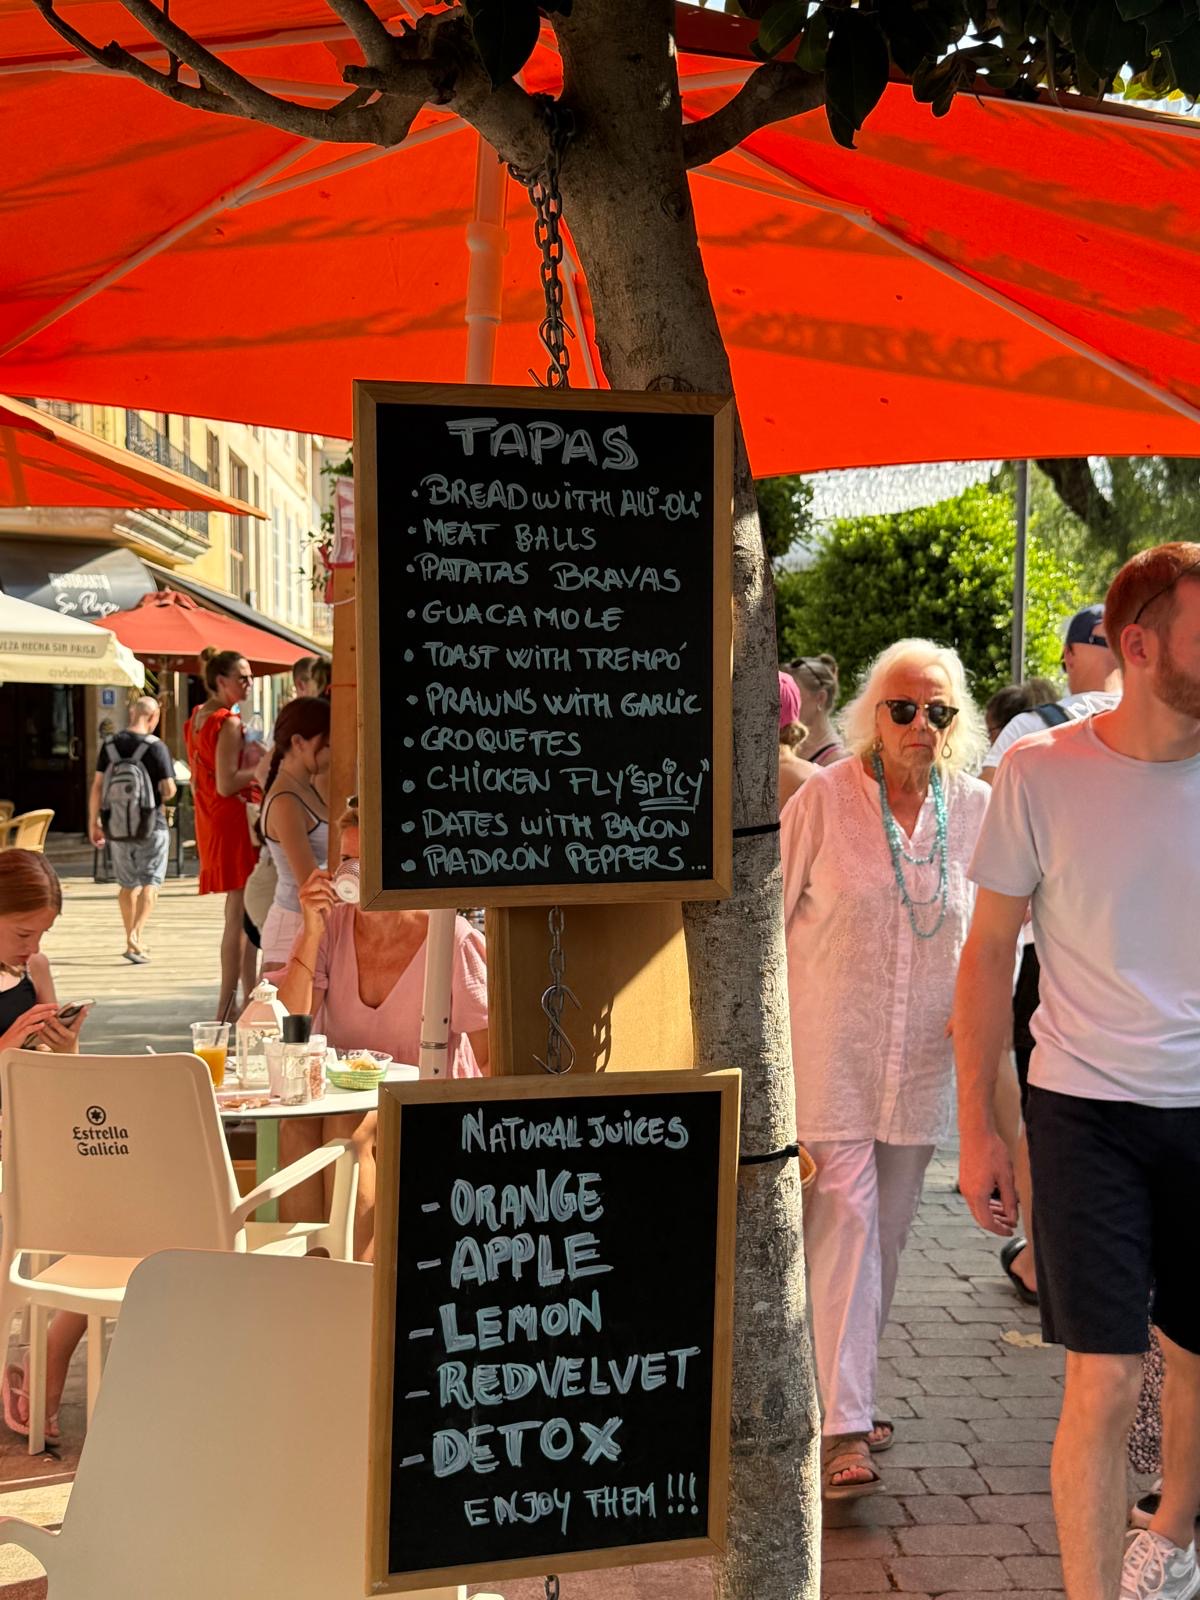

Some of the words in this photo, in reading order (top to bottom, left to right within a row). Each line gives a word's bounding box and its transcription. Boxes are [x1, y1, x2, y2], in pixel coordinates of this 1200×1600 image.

[446, 418, 638, 470] TAPAS
[420, 474, 527, 510] BREAD
[423, 518, 500, 546] MEAT
[515, 524, 596, 552] BALLS
[414, 553, 528, 584] PATATAS
[549, 562, 680, 592] BRAVAS
[423, 642, 499, 669] TOAST
[426, 682, 537, 716] PRAWNS
[560, 768, 623, 804] FLY
[422, 809, 508, 838] DATES
[601, 812, 689, 842] BACON
[72, 1126, 129, 1140] Estrella
[77, 1141, 130, 1156] Galicia
[462, 1108, 583, 1153] NATURAL
[451, 1169, 604, 1231] ORANGE
[451, 1232, 614, 1289] APPLE
[439, 1290, 601, 1353] LEMON
[437, 1344, 701, 1409] REDVELVET
[433, 1416, 623, 1478] DETOX
[464, 1489, 570, 1535] ENJOY
[583, 1482, 656, 1518] THEM
